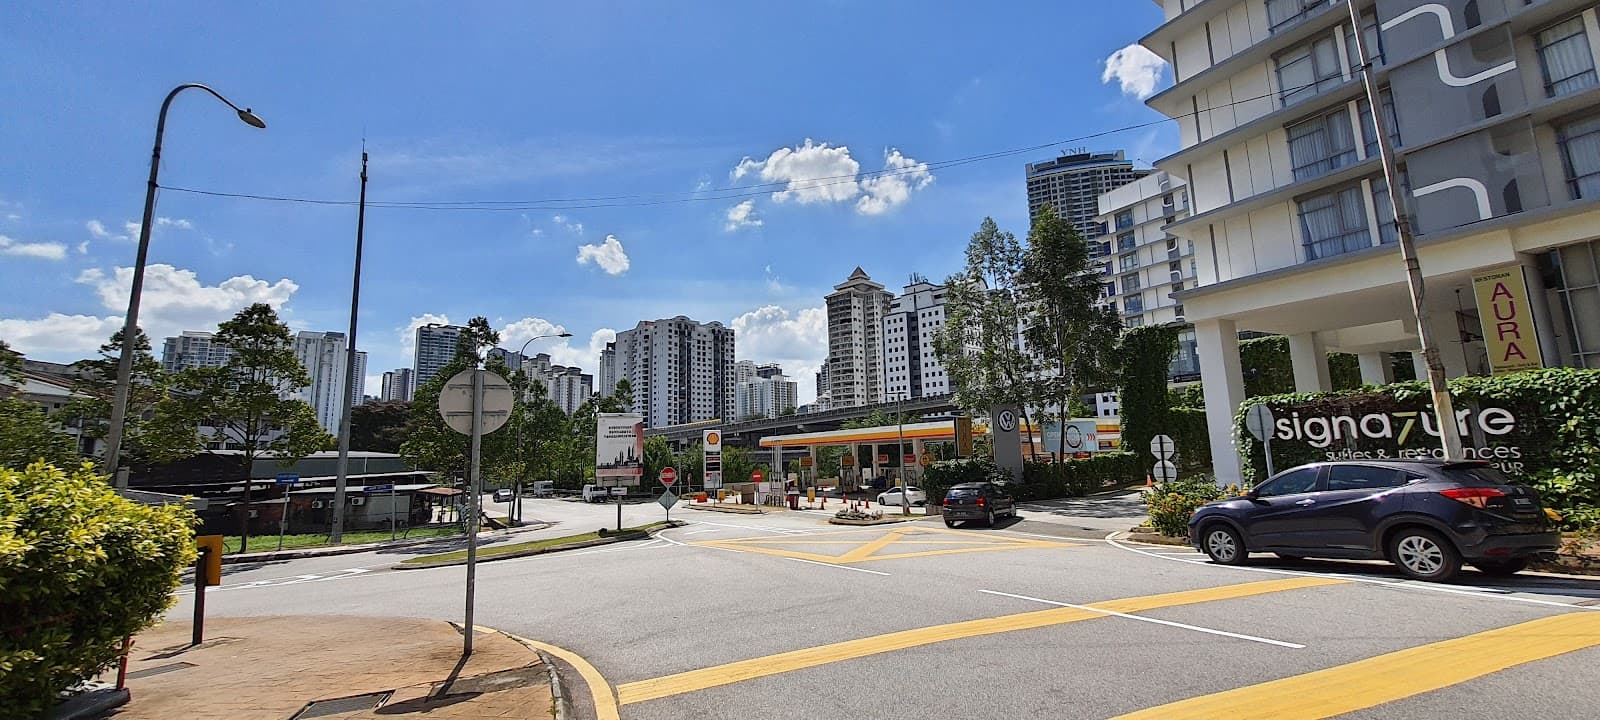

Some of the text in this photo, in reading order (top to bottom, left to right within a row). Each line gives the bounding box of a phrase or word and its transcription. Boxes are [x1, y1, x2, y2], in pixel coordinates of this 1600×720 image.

[1061, 146, 1086, 156] YNH
[1491, 282, 1528, 361] AURA
[1398, 446, 1521, 460] residnces
